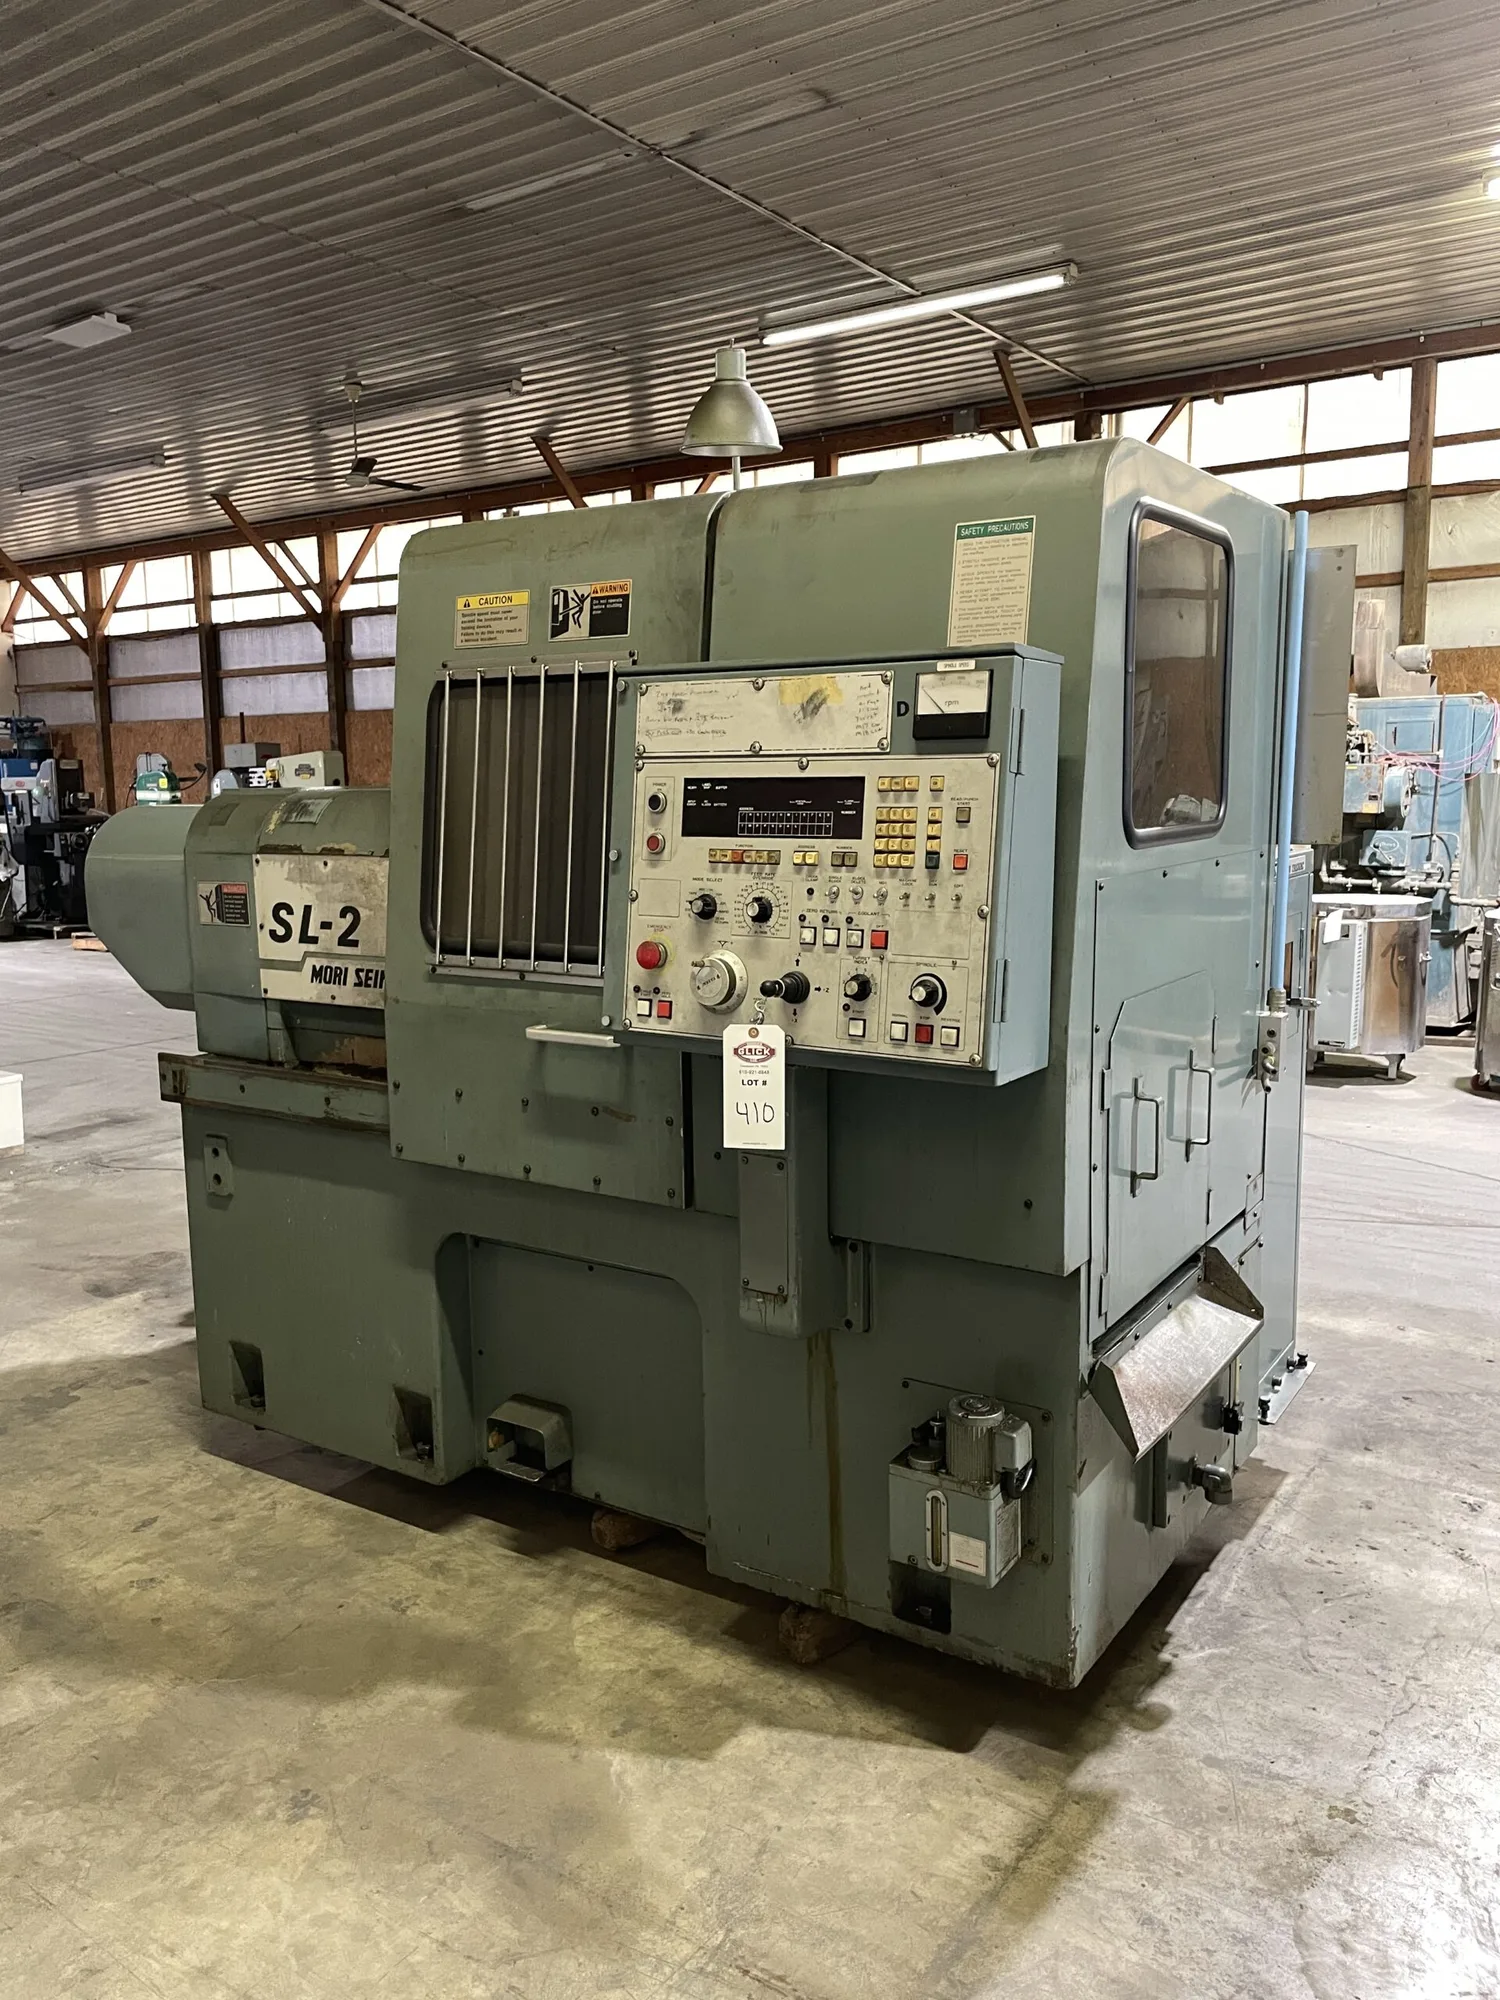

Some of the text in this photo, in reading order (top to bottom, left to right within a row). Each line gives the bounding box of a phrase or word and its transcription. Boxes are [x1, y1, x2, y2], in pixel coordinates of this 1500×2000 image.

[960, 522, 1029, 536] SAFETY PRECAUTIONS
[599, 583, 628, 594] WARNING
[478, 596, 512, 606] CAUTION
[897, 701, 910, 717] D
[269, 902, 361, 948] SL-2
[310, 964, 348, 986] MORI
[738, 1047, 770, 1056] GLICK
[736, 1102, 774, 1125] 410
